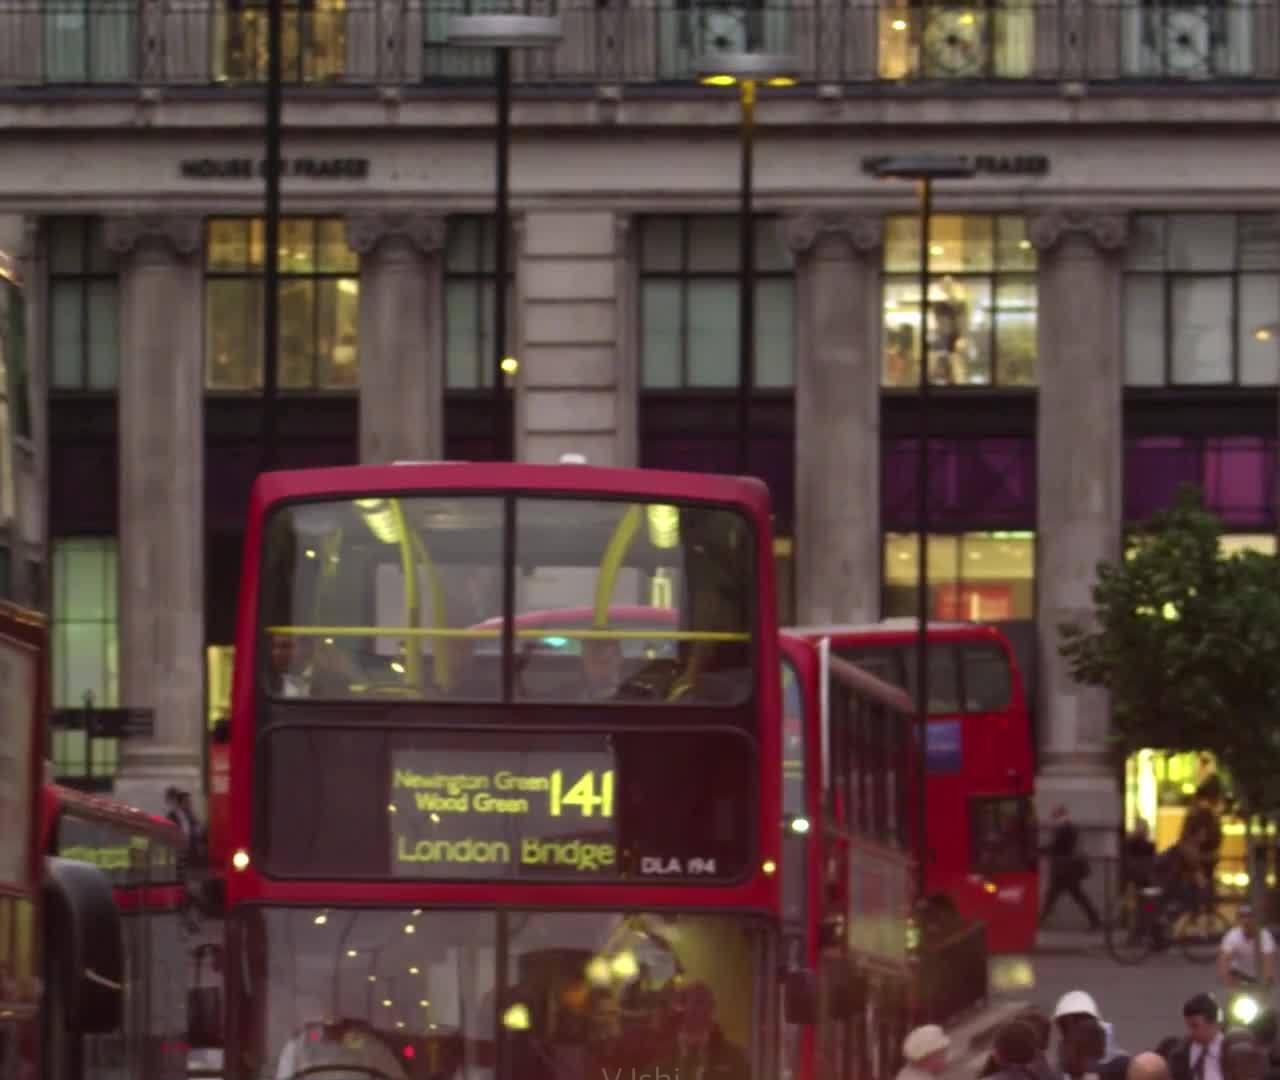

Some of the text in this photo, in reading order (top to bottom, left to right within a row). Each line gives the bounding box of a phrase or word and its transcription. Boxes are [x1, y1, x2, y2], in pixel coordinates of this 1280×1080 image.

[394, 769, 549, 794] Newington Green
[550, 769, 615, 817] 141
[415, 792, 529, 814] Wood Green
[397, 835, 617, 872] London Bridge
[641, 856, 682, 875] DLA
